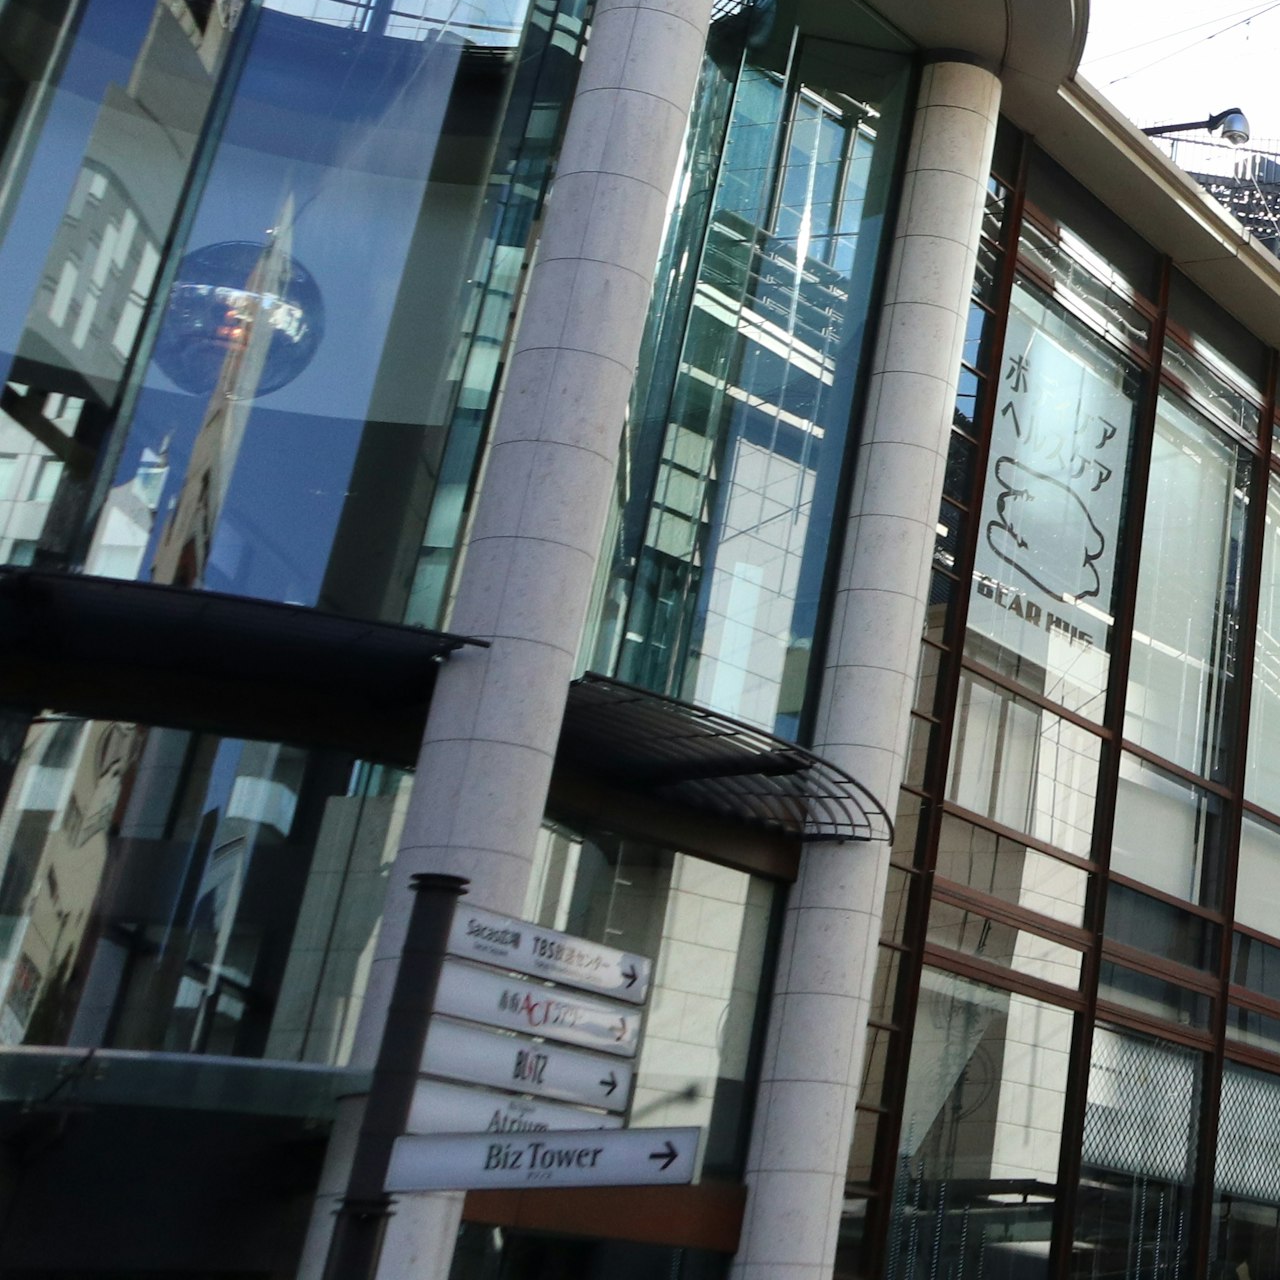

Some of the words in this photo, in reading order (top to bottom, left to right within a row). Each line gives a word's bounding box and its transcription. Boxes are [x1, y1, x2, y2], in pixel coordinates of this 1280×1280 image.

[977, 575, 1042, 628] GEAR
[487, 1110, 549, 1134] Atrium
[484, 1142, 523, 1170] Biz
[527, 1141, 604, 1169] Tower
